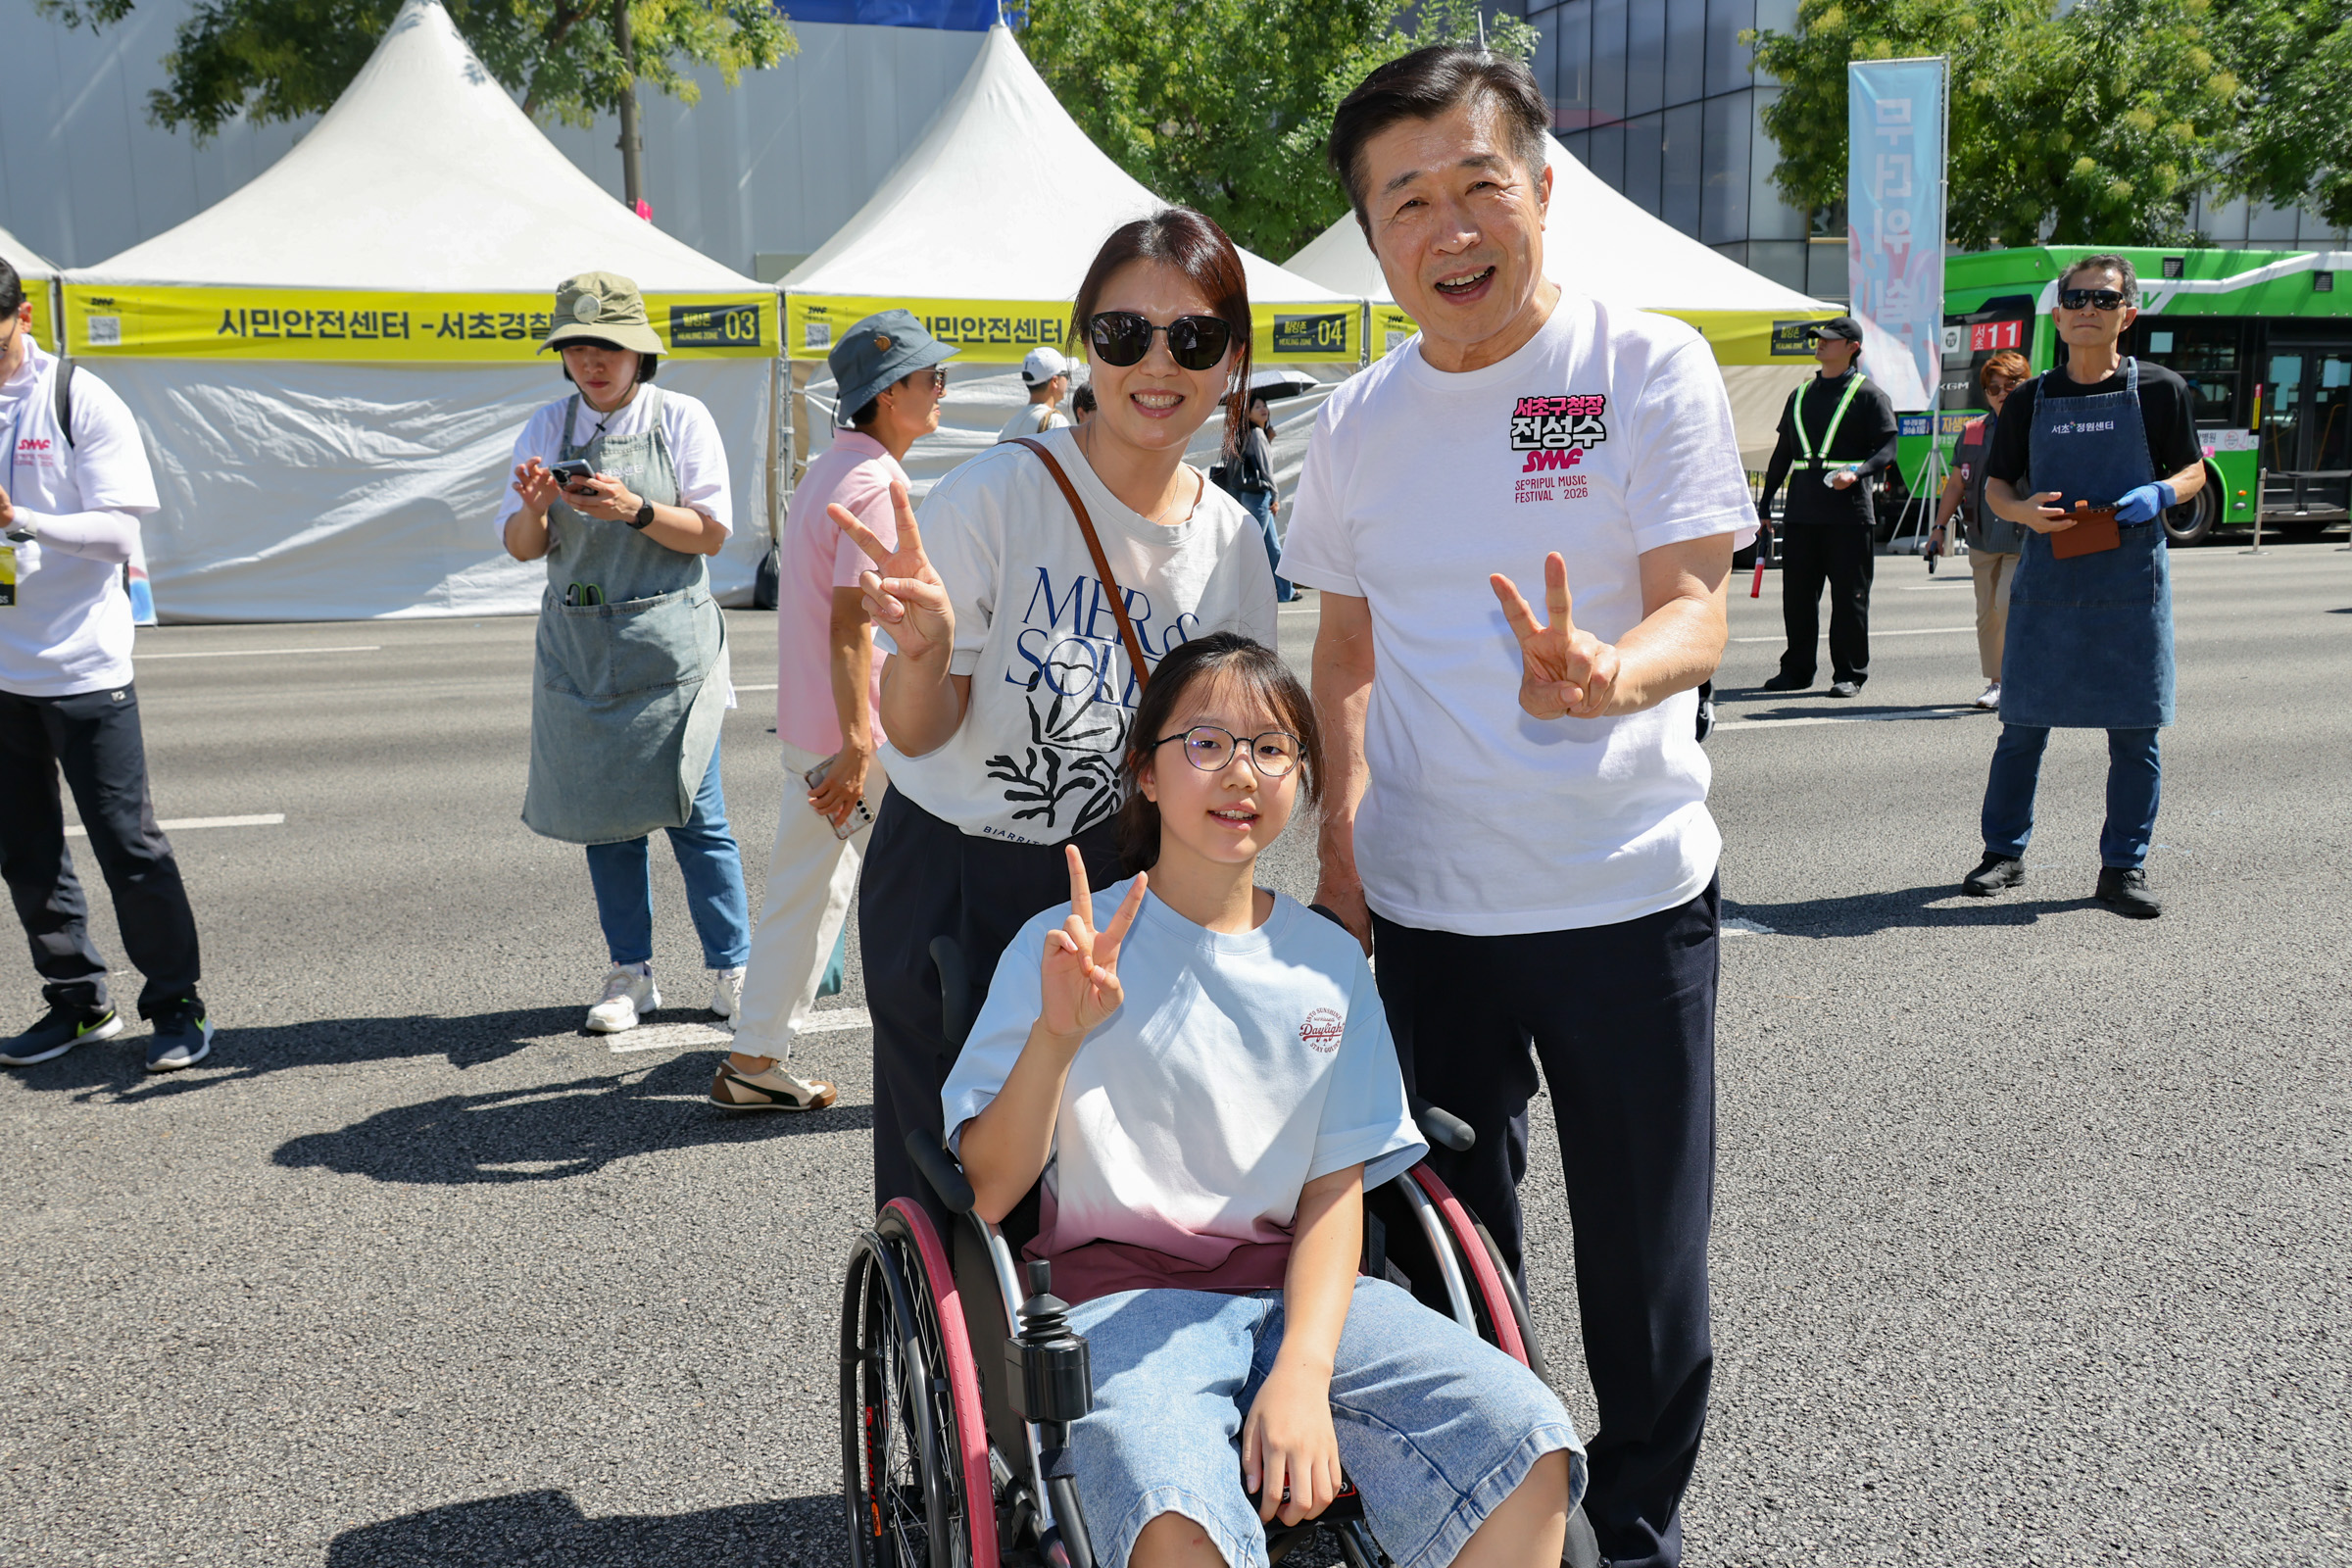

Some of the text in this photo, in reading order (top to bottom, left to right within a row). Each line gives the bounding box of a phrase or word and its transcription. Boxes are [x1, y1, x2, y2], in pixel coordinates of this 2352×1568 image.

[218, 309, 410, 339] 시민안전센터
[725, 311, 756, 340] 03
[1284, 320, 1307, 334] 힐링존
[1317, 319, 1344, 346] 04
[703, 331, 719, 340] ZONE
[1278, 337, 1312, 346] HEALING ZONE
[1974, 324, 1985, 350] 서초
[1987, 322, 2017, 348] 11
[1514, 395, 1604, 416] 서초구청장
[1511, 416, 1605, 449] 전성수
[2051, 420, 2115, 434] 서초 정원센터
[1558, 475, 1588, 488] MUSIC
[1515, 487, 1589, 504] FESTIVAL 2026
[1310, 1042, 1323, 1053] STAY
